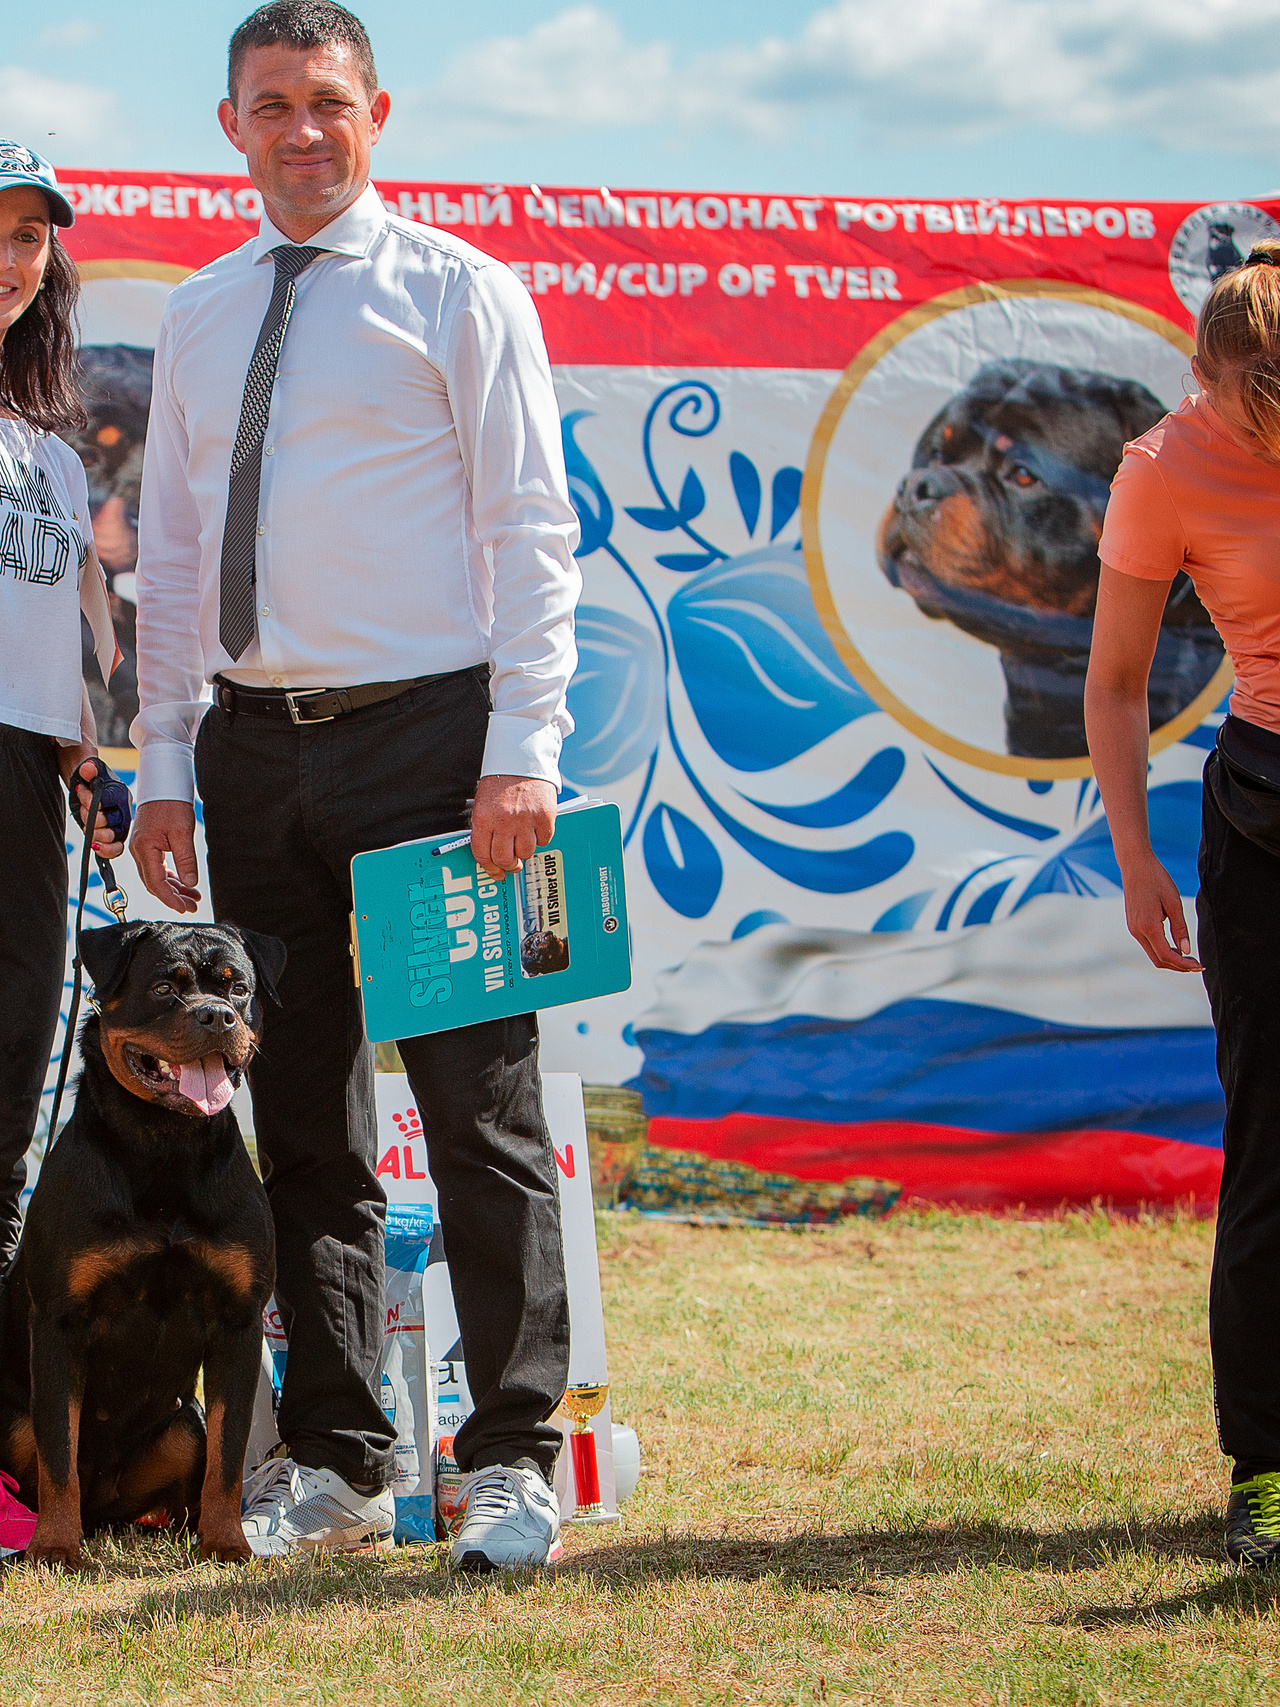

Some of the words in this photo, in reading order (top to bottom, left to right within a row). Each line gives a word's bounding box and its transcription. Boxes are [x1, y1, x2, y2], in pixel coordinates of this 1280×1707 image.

[523, 192, 822, 231] ЧЕМПИОНАТ
[834, 198, 1157, 240] РОТВЕЙЛЕРОВ
[718, 263, 777, 297] OF
[785, 263, 903, 301] TVER
[544, 854, 557, 877] CUP
[546, 877, 560, 910] Silver
[599, 866, 611, 917] TABOOSPORT
[481, 904, 503, 961] Silver
[548, 909, 561, 927] VII
[483, 964, 505, 993] VII
